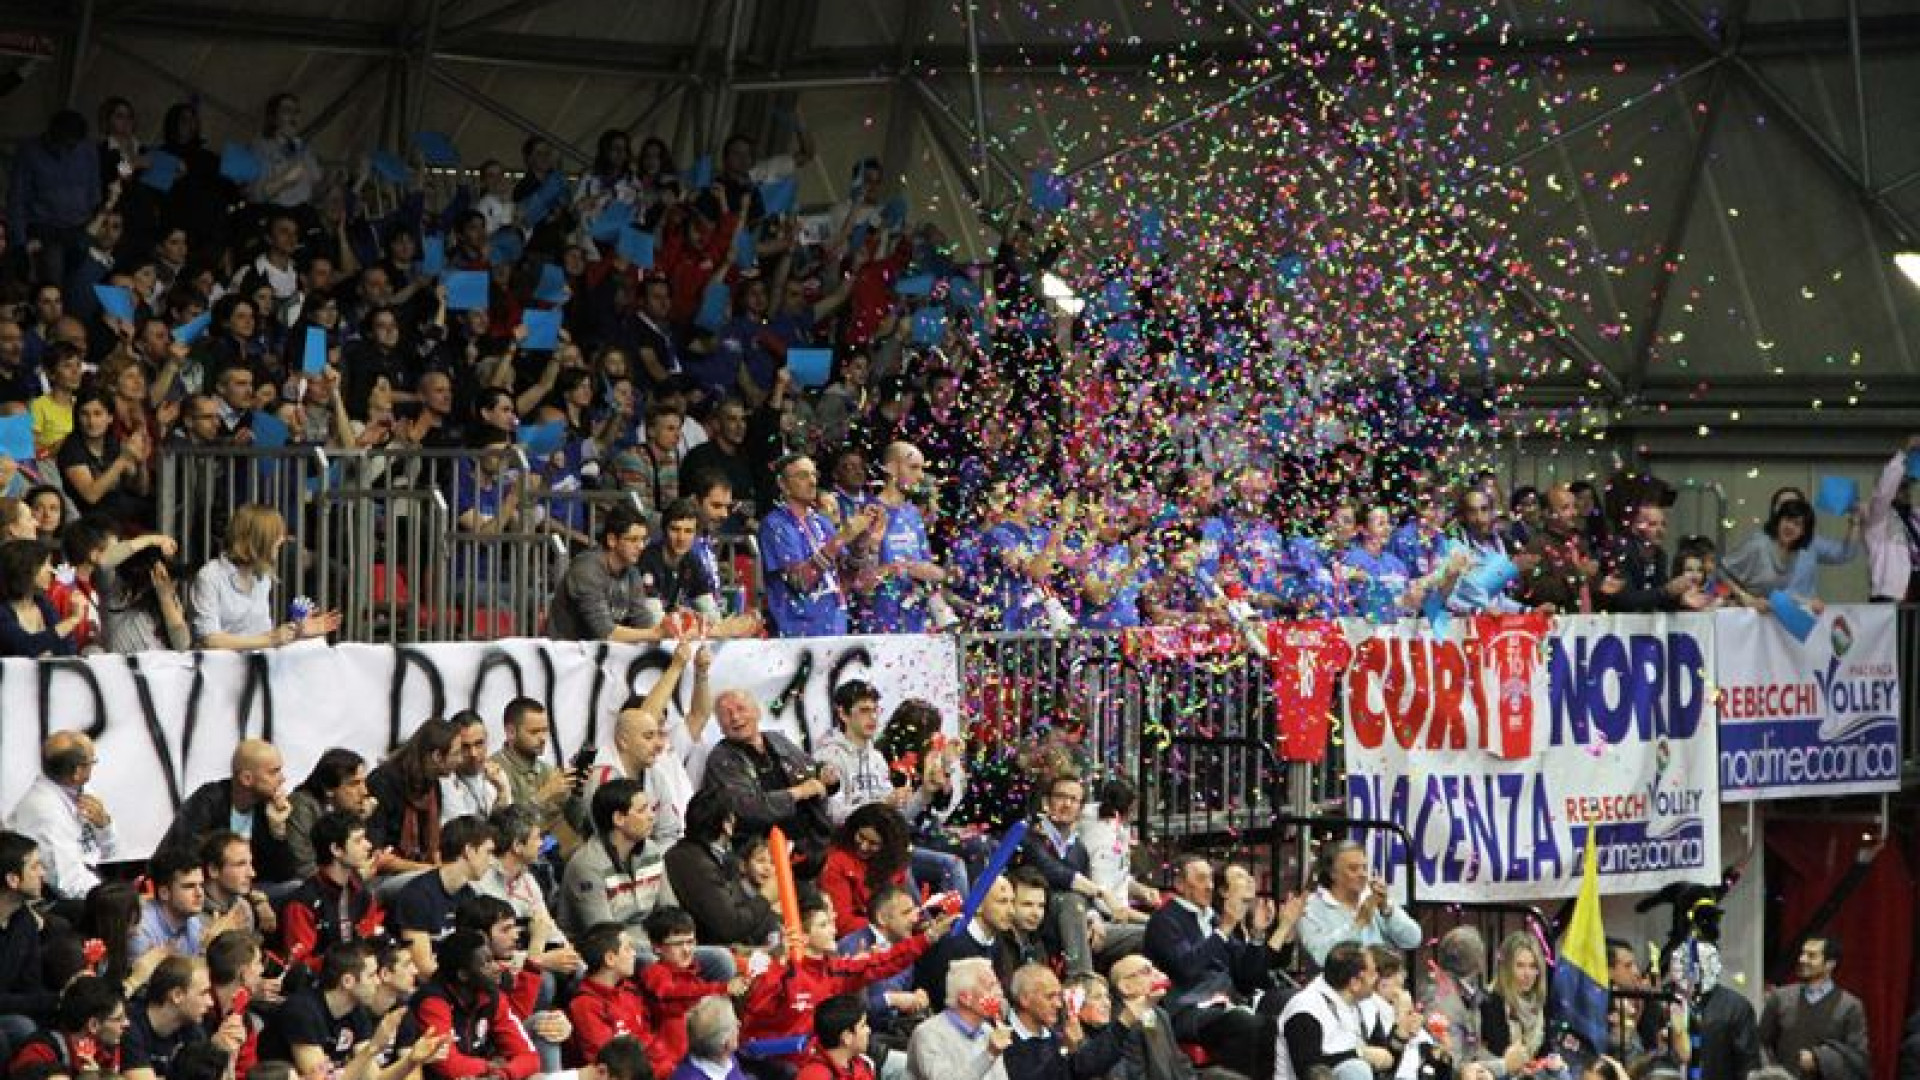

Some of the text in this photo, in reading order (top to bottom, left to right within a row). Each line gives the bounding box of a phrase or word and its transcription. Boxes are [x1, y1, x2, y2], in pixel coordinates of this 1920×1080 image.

[1549, 632, 1705, 746] NORD
[1717, 682, 1818, 719] REBECCHI
[1349, 771, 1561, 886] PIACENZA
